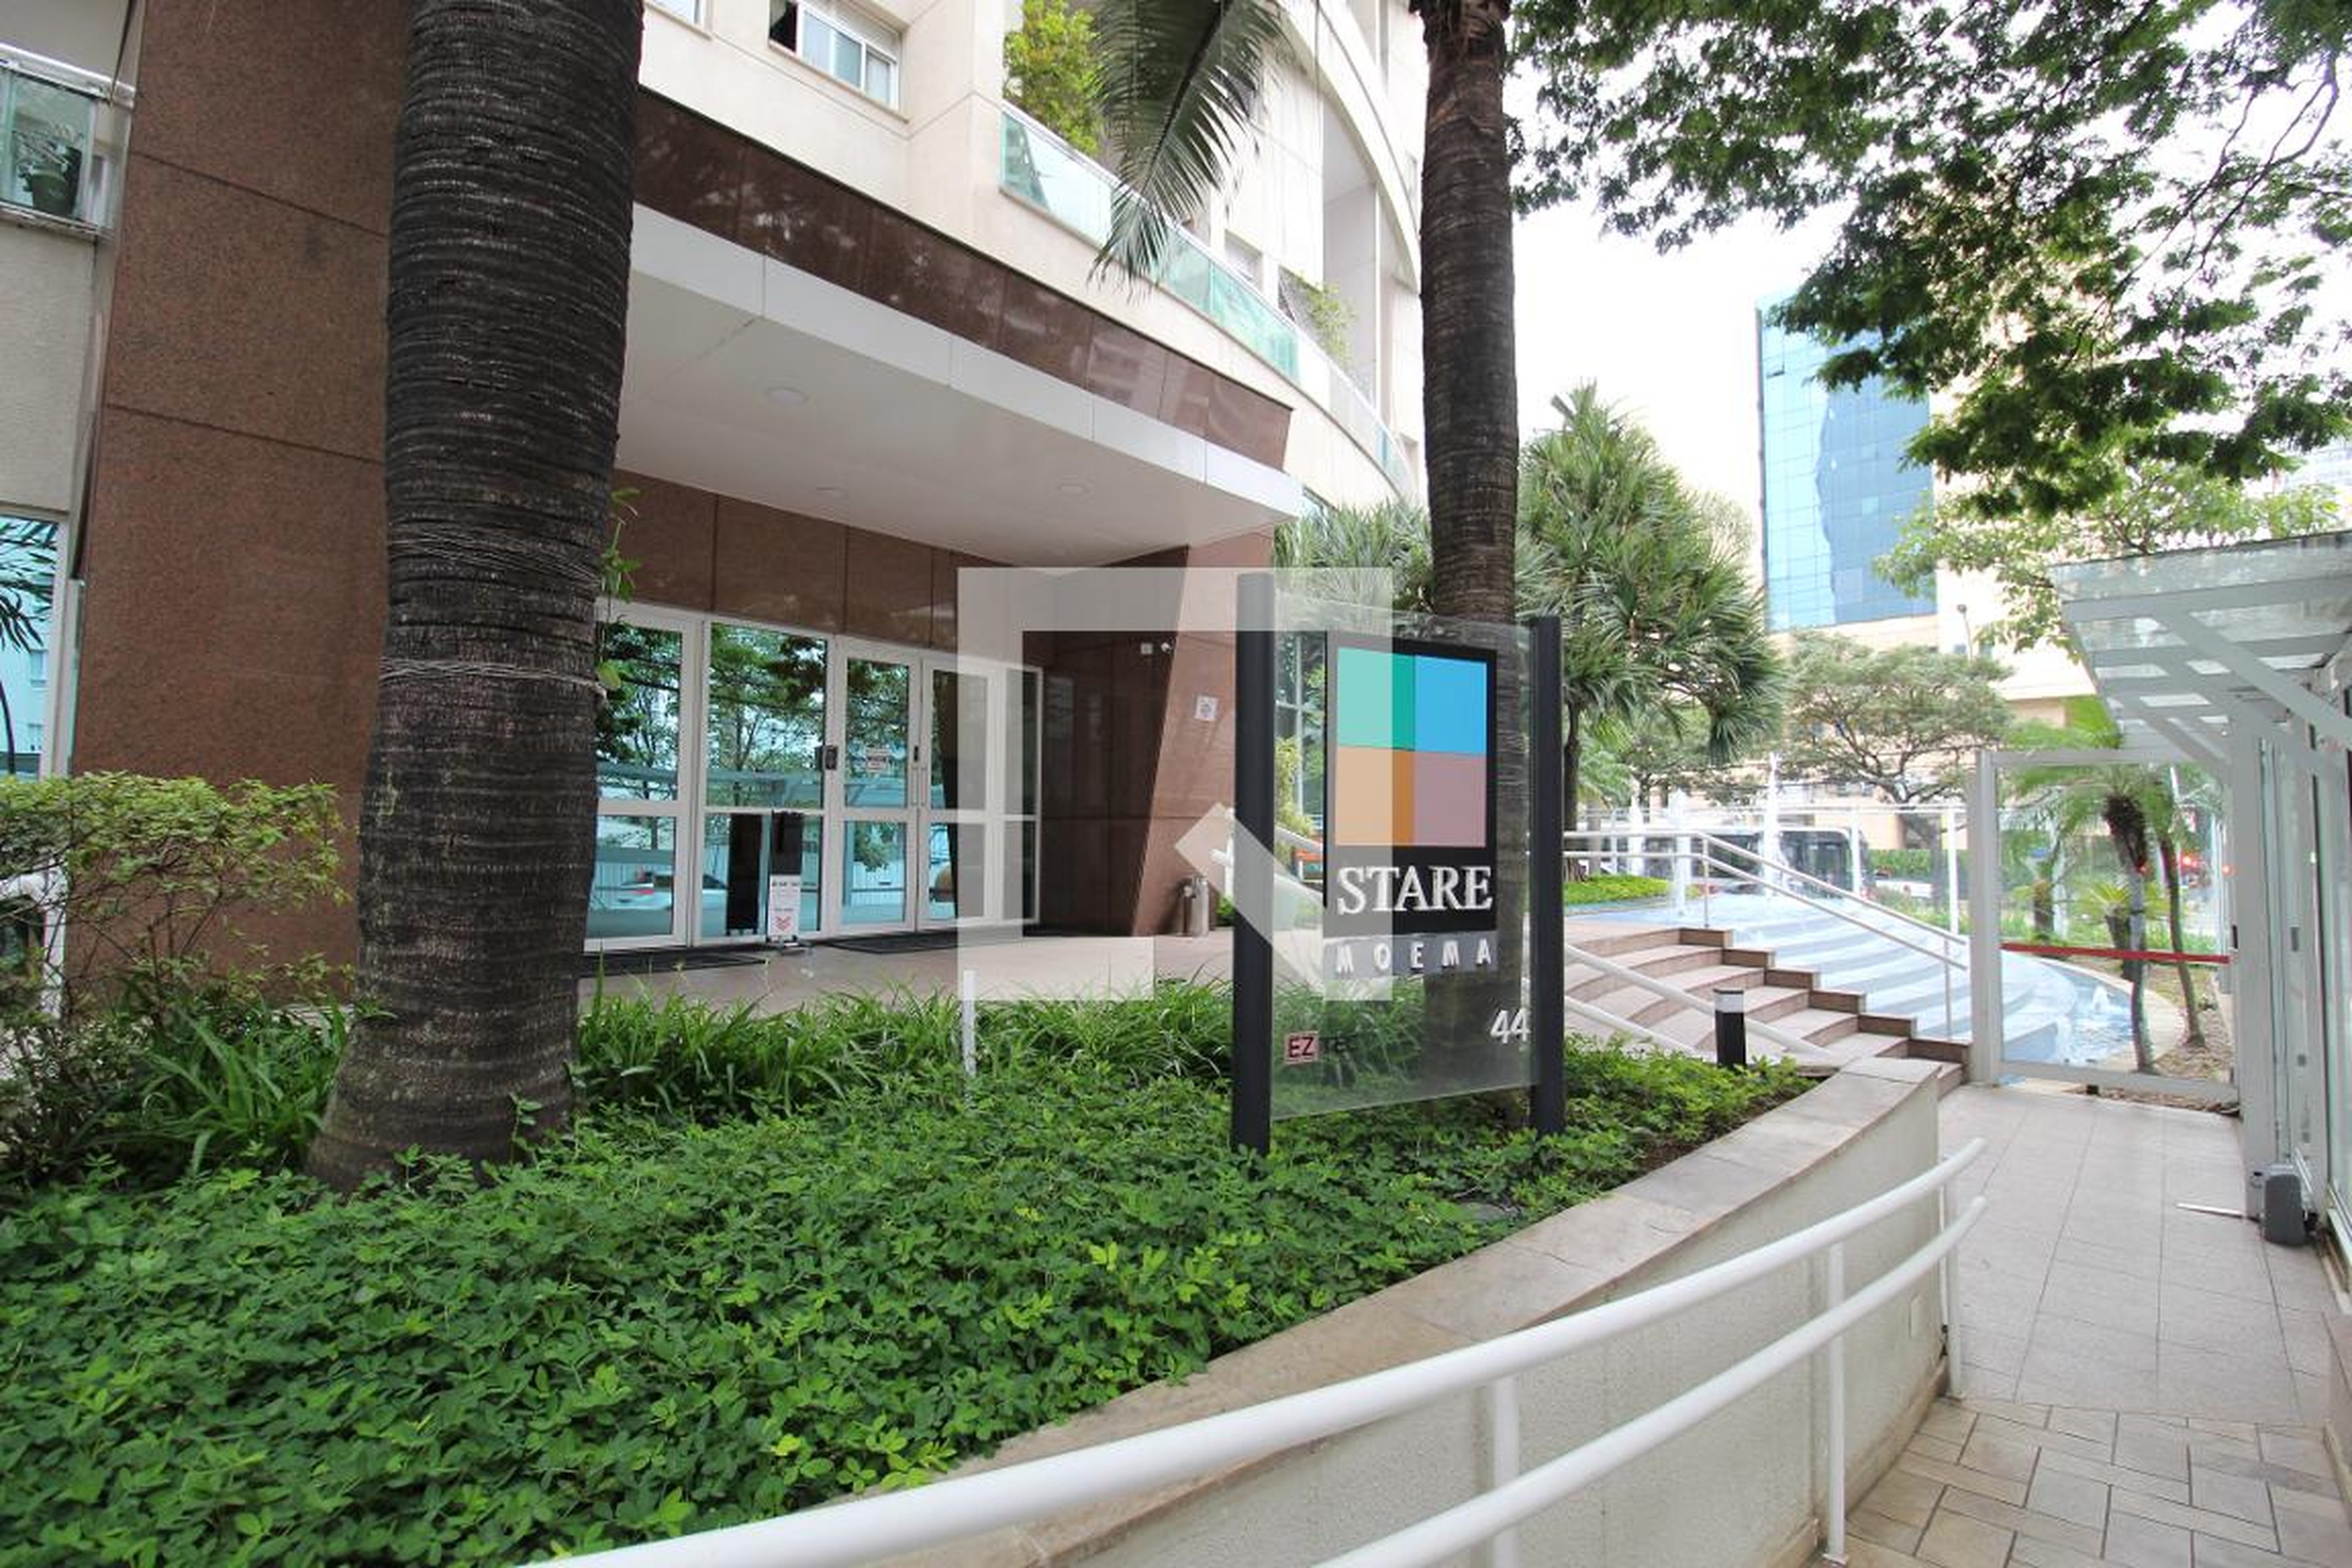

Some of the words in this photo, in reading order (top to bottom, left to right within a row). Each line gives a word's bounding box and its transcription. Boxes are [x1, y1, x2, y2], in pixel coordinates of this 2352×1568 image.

[1336, 865, 1493, 914] STARE
[1336, 938, 1492, 973] MOEMA
[1490, 1008, 1531, 1044] 44
